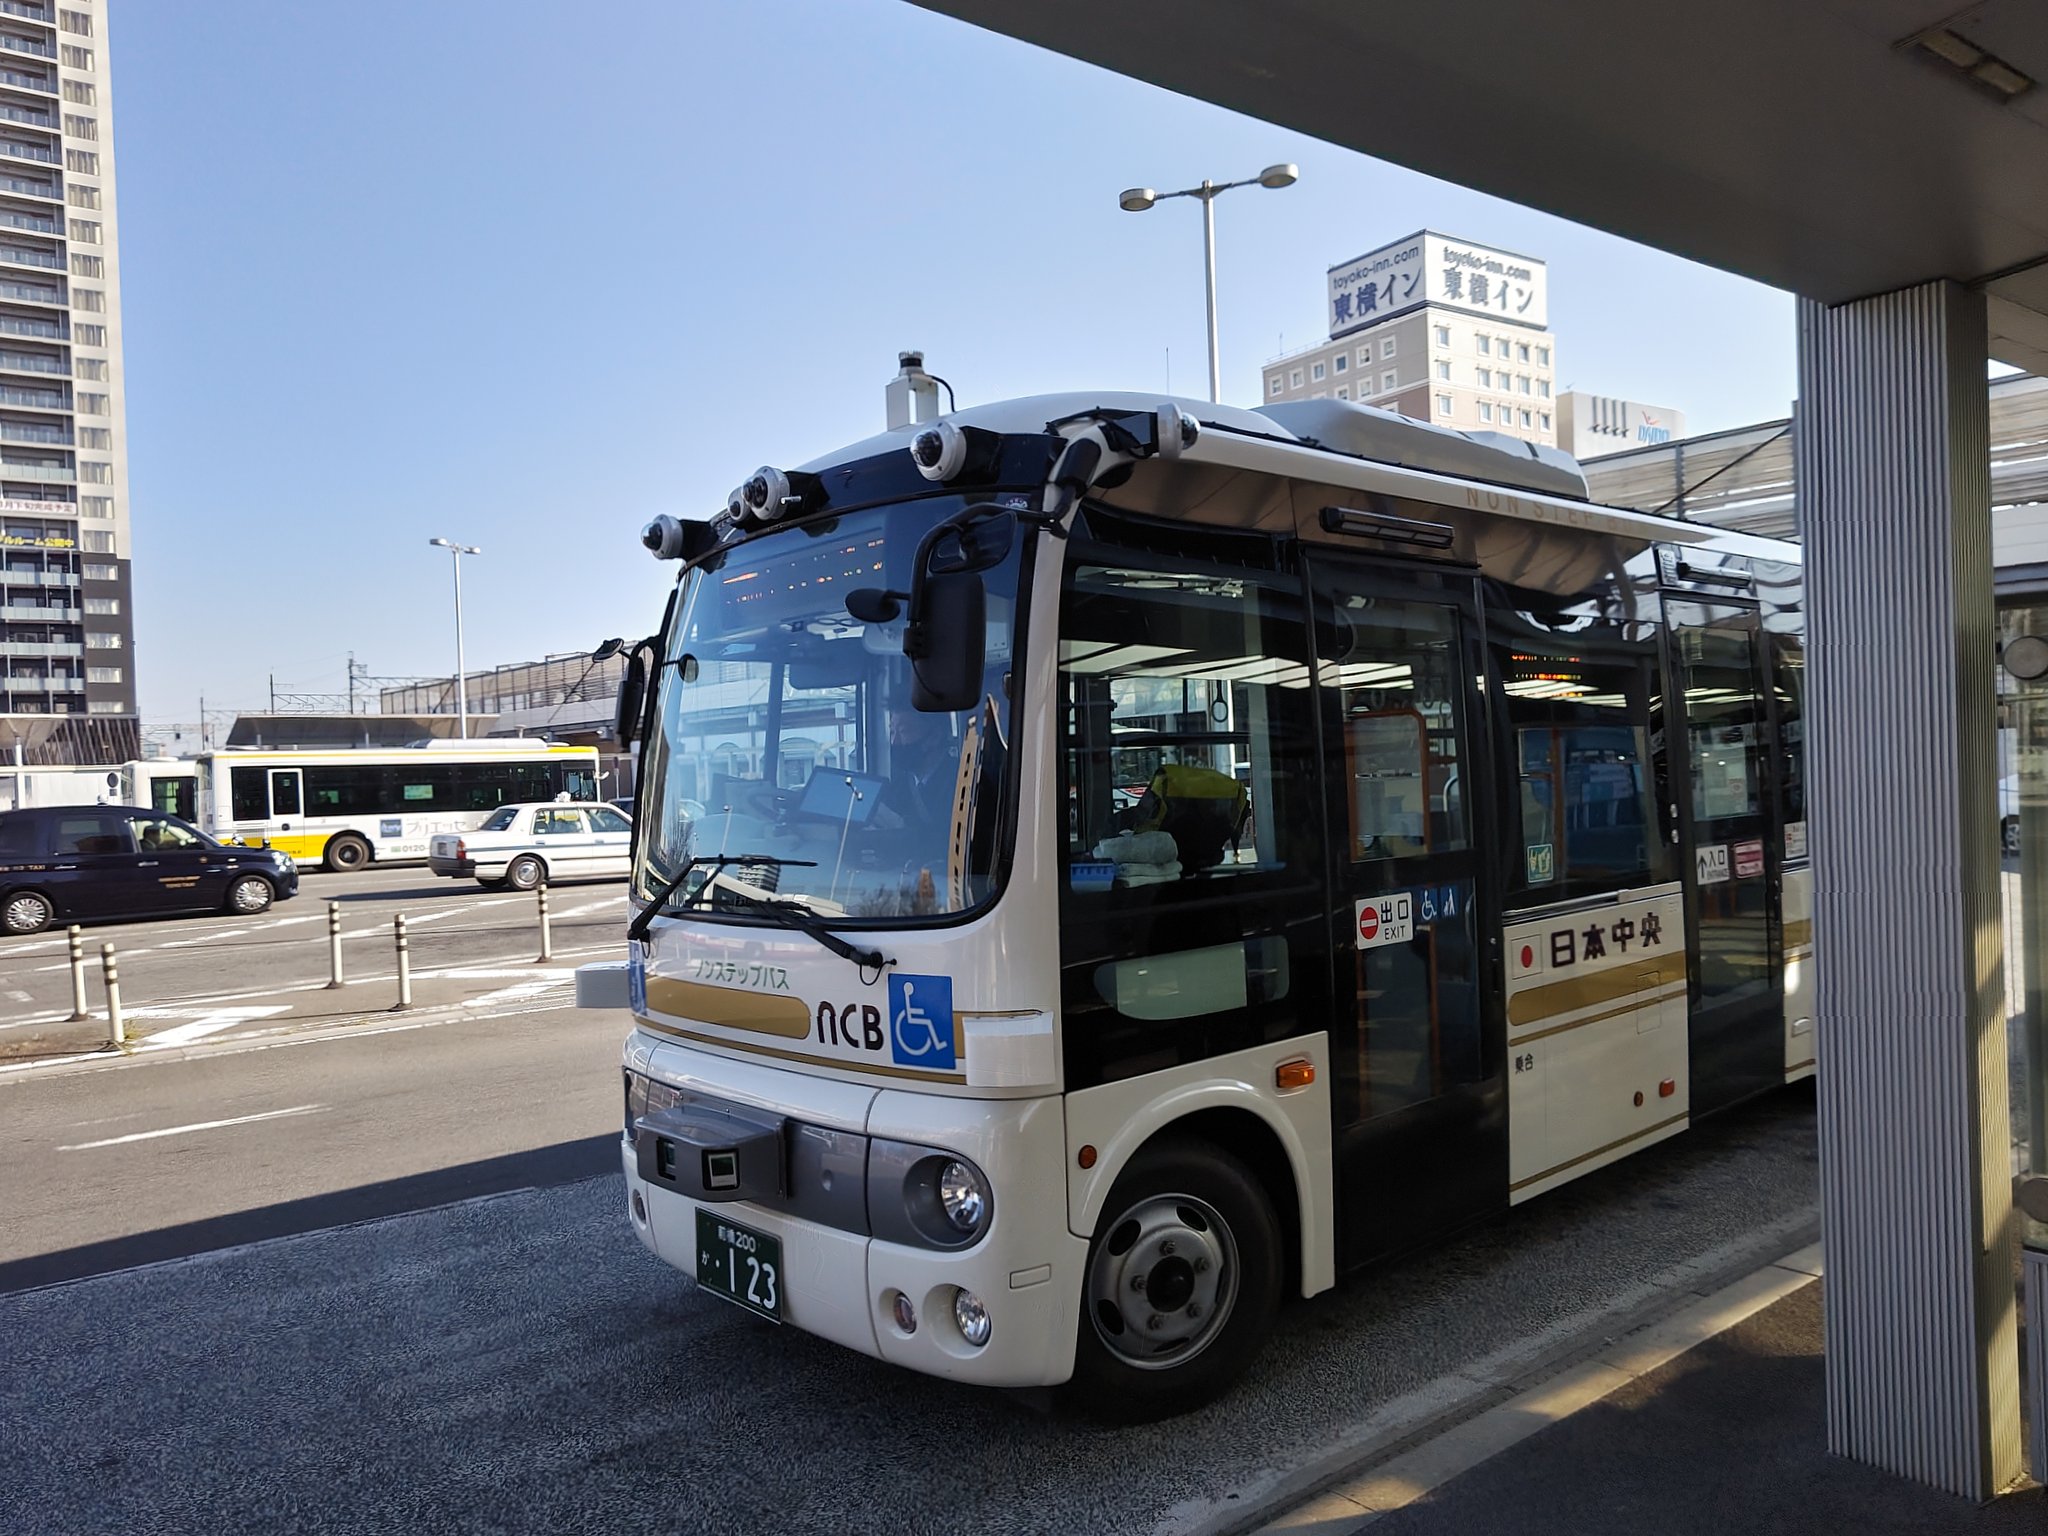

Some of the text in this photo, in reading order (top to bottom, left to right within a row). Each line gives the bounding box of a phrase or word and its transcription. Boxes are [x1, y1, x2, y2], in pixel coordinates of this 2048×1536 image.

[1333, 246, 1420, 290] toyoko-inn.com
[1443, 246, 1532, 282] toyoko-inn.com
[1332, 267, 1422, 327] 東横イン
[1442, 267, 1534, 313] 東横イン
[1466, 487, 1519, 515] NON
[1709, 850, 1725, 866] 入口
[1381, 899, 1408, 924] 出口
[1385, 926, 1406, 940] EXIT
[1551, 912, 1662, 968] 日本中央
[696, 958, 790, 990] ノンステップバス
[1515, 1053, 1534, 1075] 乗合
